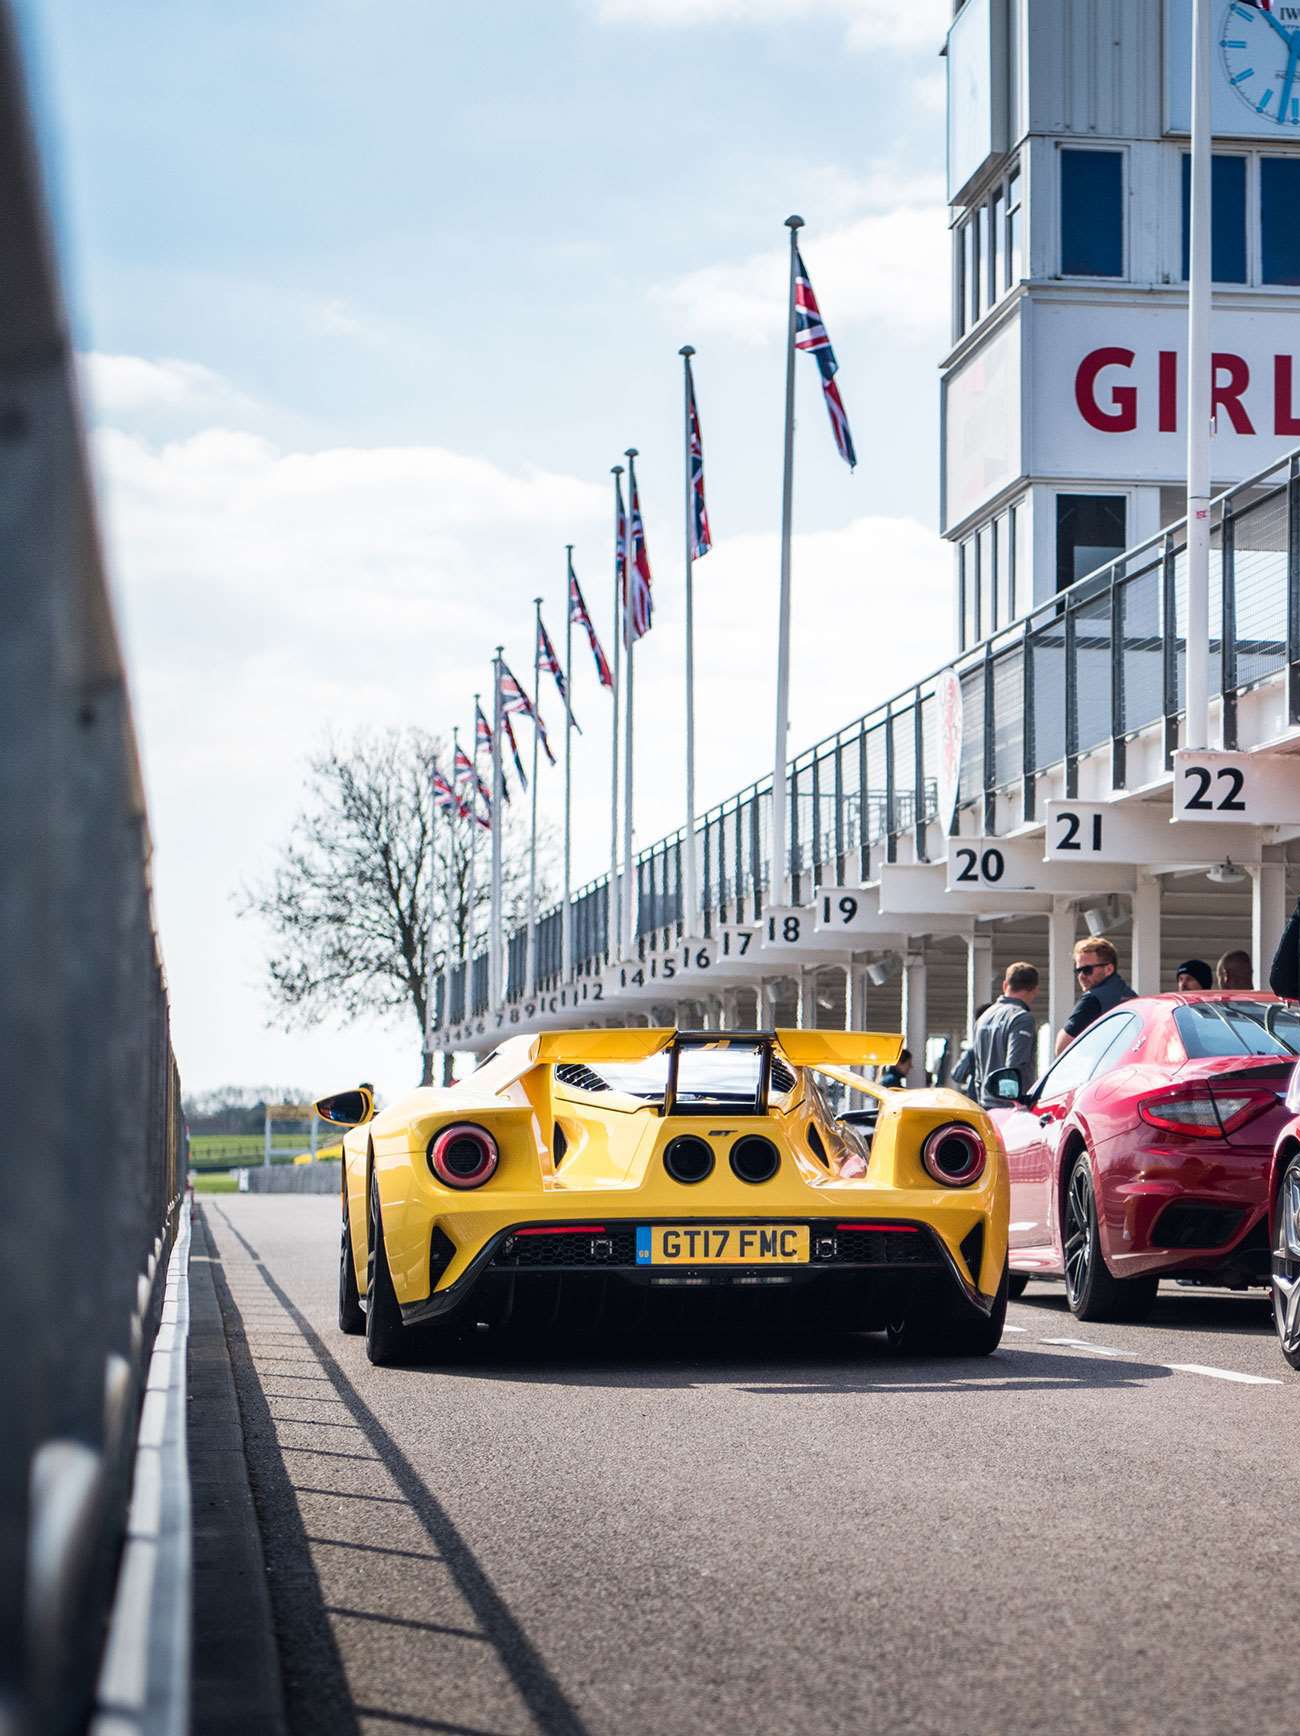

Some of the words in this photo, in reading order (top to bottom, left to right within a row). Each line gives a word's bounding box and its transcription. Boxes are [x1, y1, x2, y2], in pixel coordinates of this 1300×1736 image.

[1184, 767, 1246, 812] 22
[1056, 812, 1103, 851] 21
[956, 848, 1005, 882] 20
[824, 896, 858, 924] 19
[769, 916, 800, 943] 18
[723, 932, 753, 956] 17
[651, 958, 676, 979] 15
[684, 947, 711, 969] 16
[621, 968, 645, 988] 14
[583, 983, 605, 1001] 12
[510, 1008, 520, 1024] 8
[525, 1003, 536, 1018] 9
[662, 1230, 730, 1258] GT17
[739, 1229, 798, 1257] FMC
